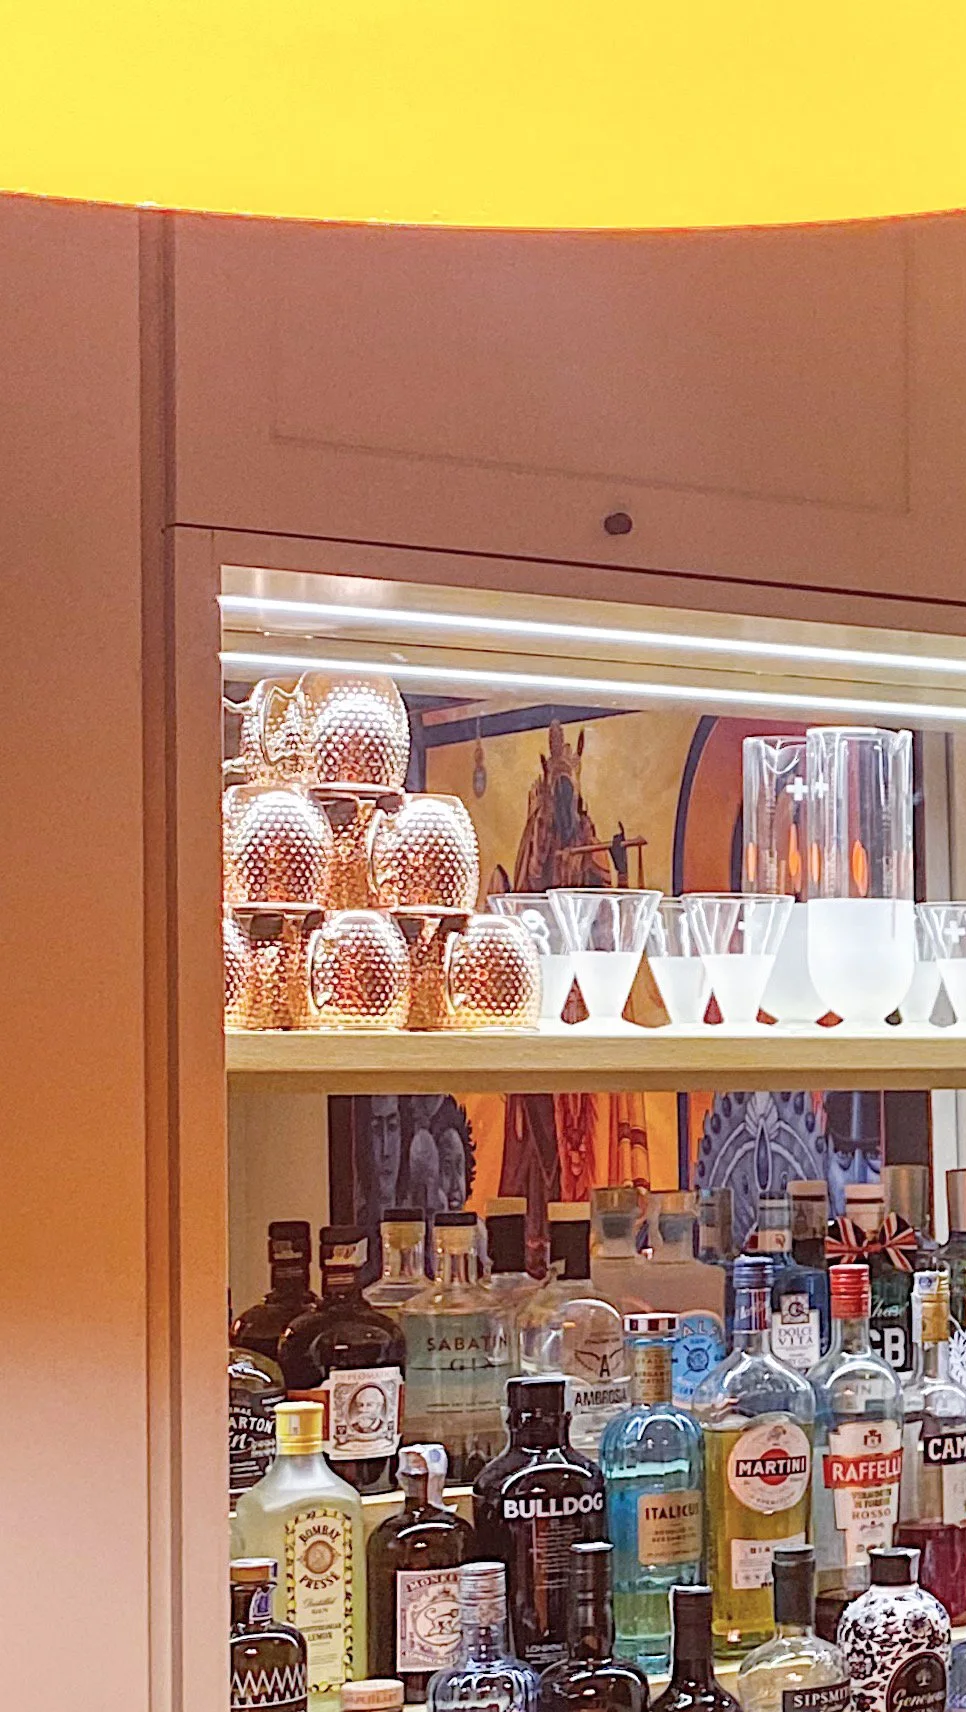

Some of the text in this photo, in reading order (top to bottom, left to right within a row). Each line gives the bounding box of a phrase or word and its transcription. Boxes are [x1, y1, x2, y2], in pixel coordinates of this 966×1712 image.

[738, 1457, 805, 1476] MARTINI
[503, 1492, 604, 1519] BULLDOG
[299, 1525, 342, 1544] BOMBAY
